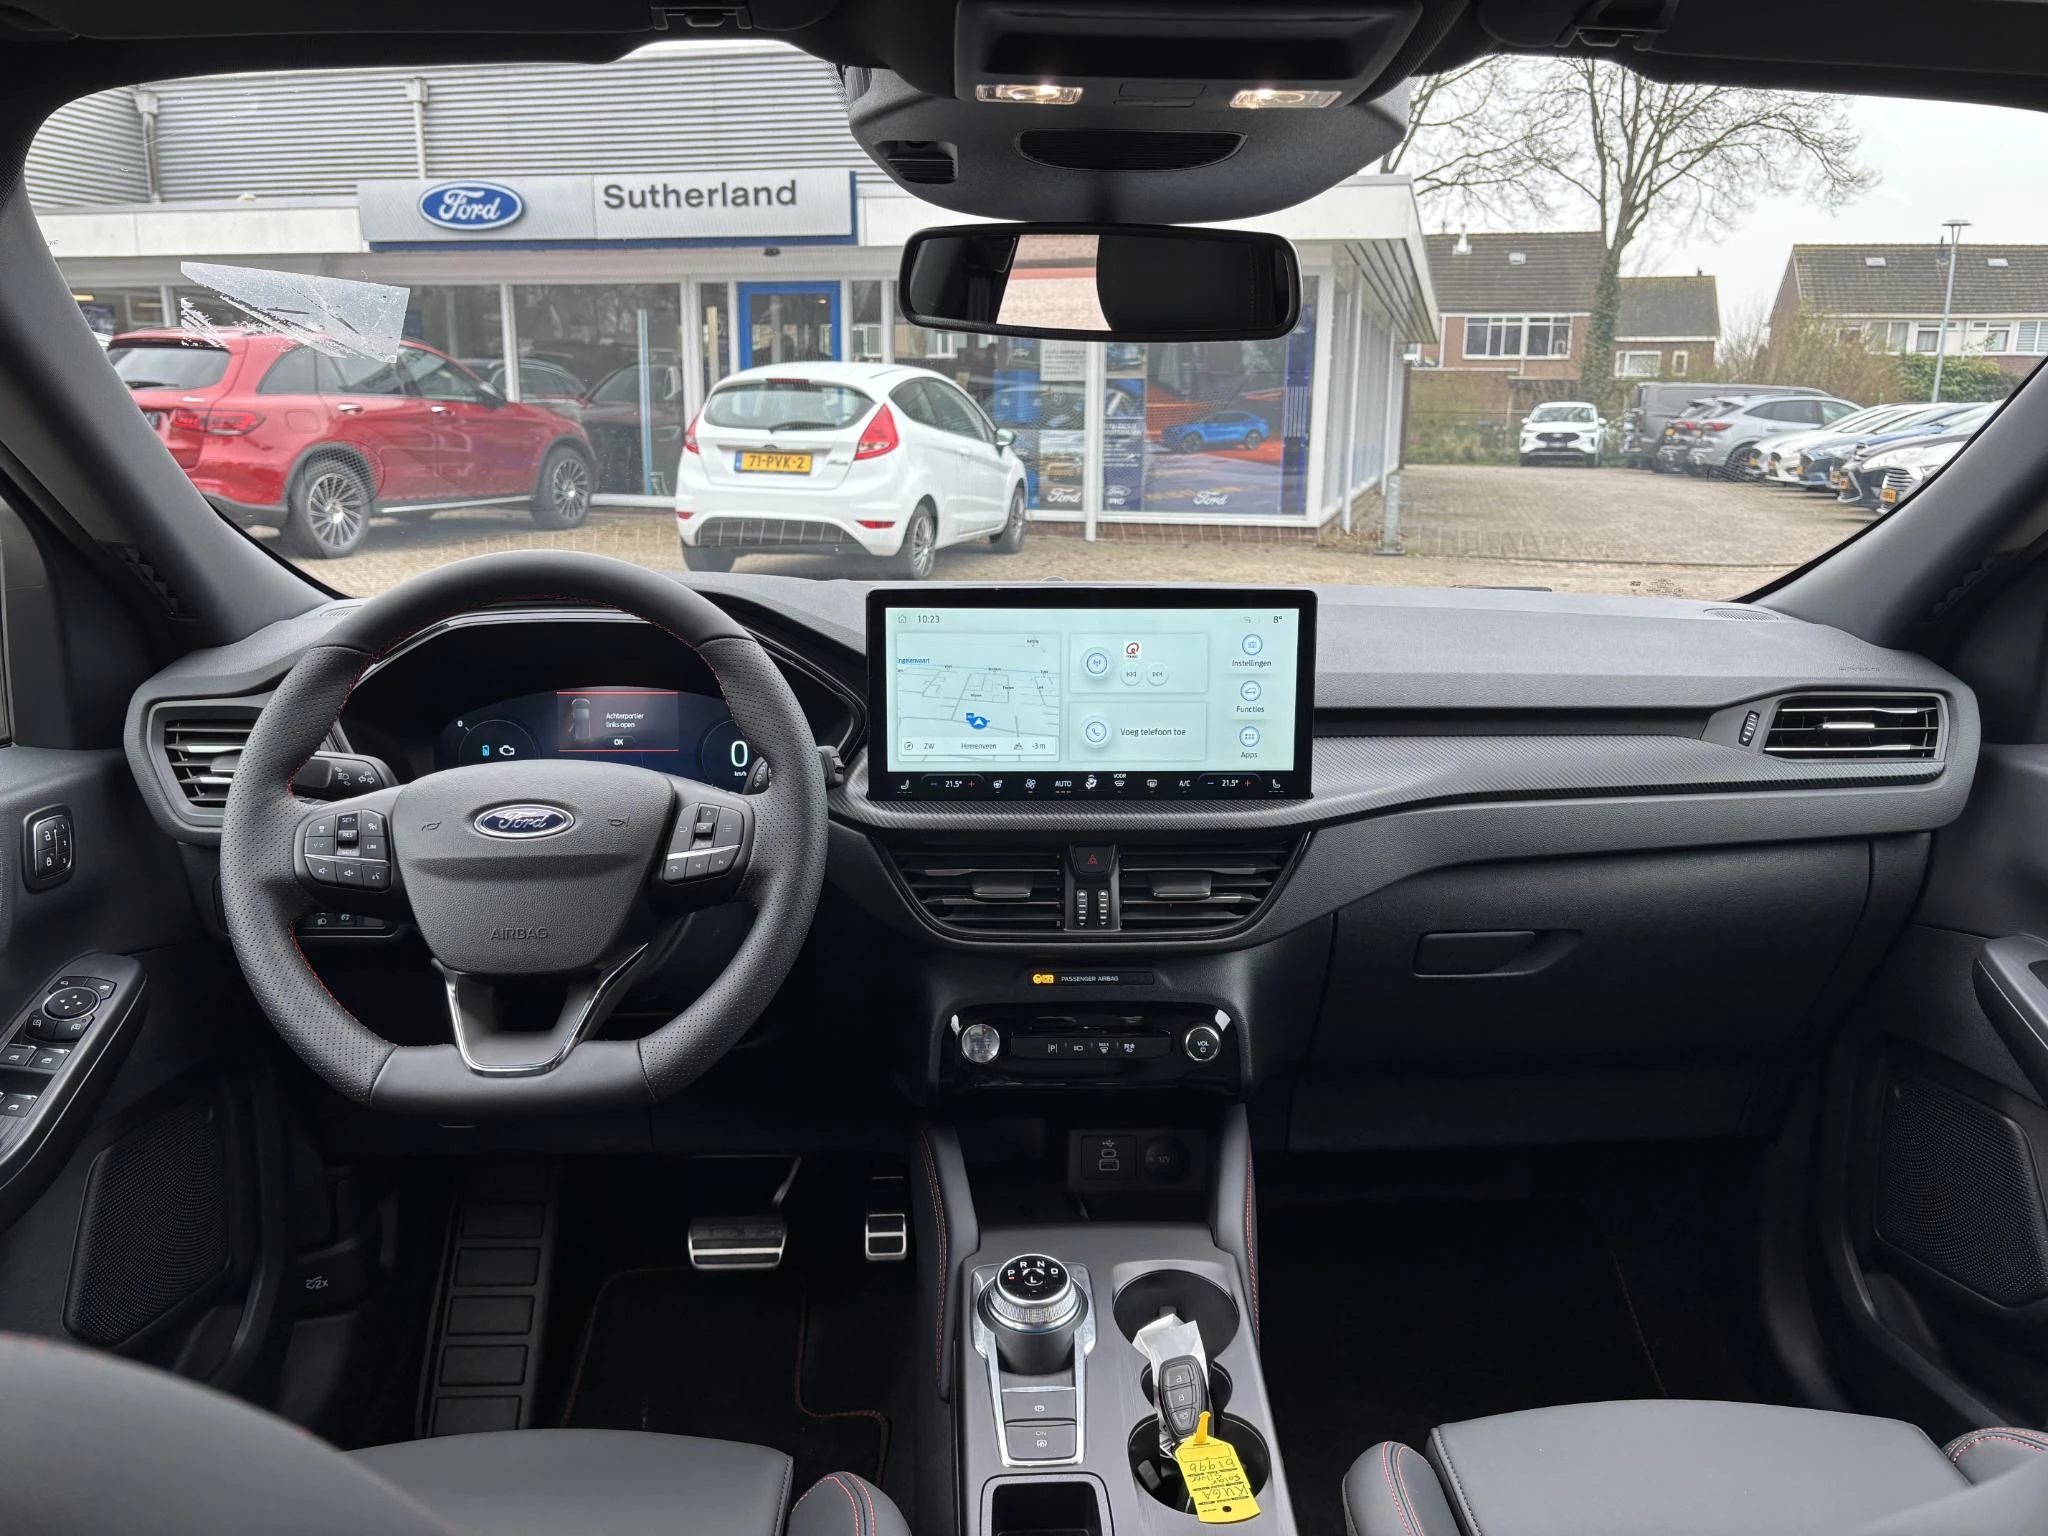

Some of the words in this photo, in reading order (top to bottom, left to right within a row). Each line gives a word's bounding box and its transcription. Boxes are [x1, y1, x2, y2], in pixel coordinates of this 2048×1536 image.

[603, 179, 797, 209] Sutherland
[437, 189, 501, 221] Ford
[748, 455, 805, 470] 71-PVK-2
[1047, 487, 1081, 504] Ford
[1193, 491, 1229, 506] Ford
[917, 615, 940, 624] 10:23
[1232, 660, 1272, 668] Instellingen
[1120, 728, 1139, 737] Voeg
[1140, 728, 1172, 736] telefoon
[731, 740, 748, 767] 0
[961, 742, 997, 750] Heerenveen
[500, 812, 549, 829] Ford
[490, 926, 549, 941] AIRBAG
[1036, 1260, 1046, 1268] N
[1050, 1267, 1059, 1275] D
[1007, 1269, 1016, 1277] P
[1030, 1275, 1038, 1283] L
[1202, 1484, 1249, 1500] KUGA
